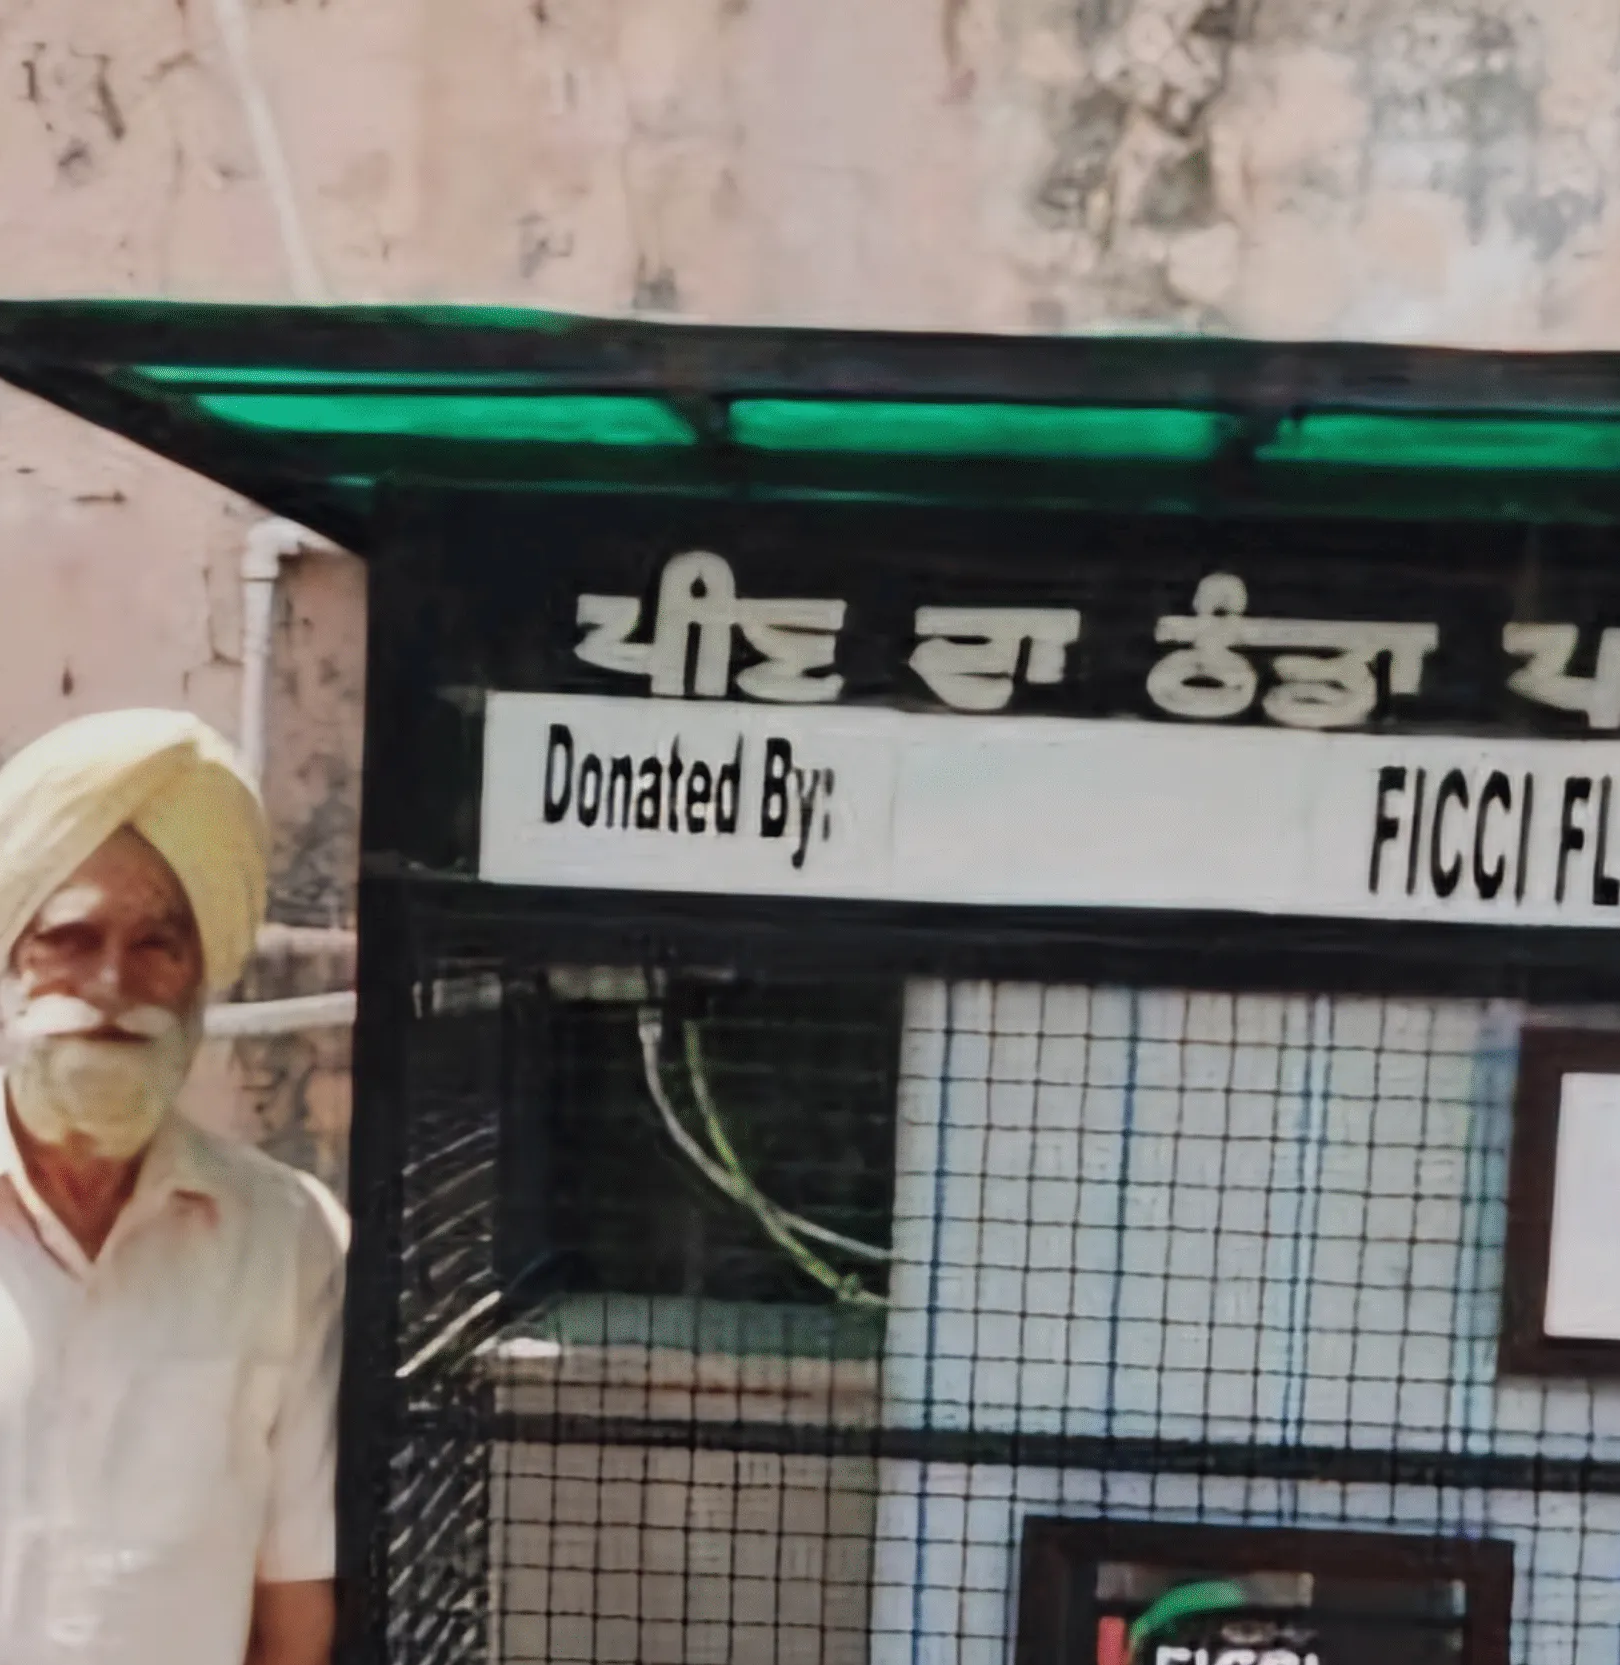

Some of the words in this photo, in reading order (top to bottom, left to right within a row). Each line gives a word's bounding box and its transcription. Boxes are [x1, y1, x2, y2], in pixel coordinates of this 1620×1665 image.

[574, 550, 848, 702] ਪੀਣ
[907, 606, 1080, 712] ਦਾ
[543, 723, 744, 834] Donated
[759, 736, 836, 869] By:
[1367, 764, 1533, 906] FICCI
